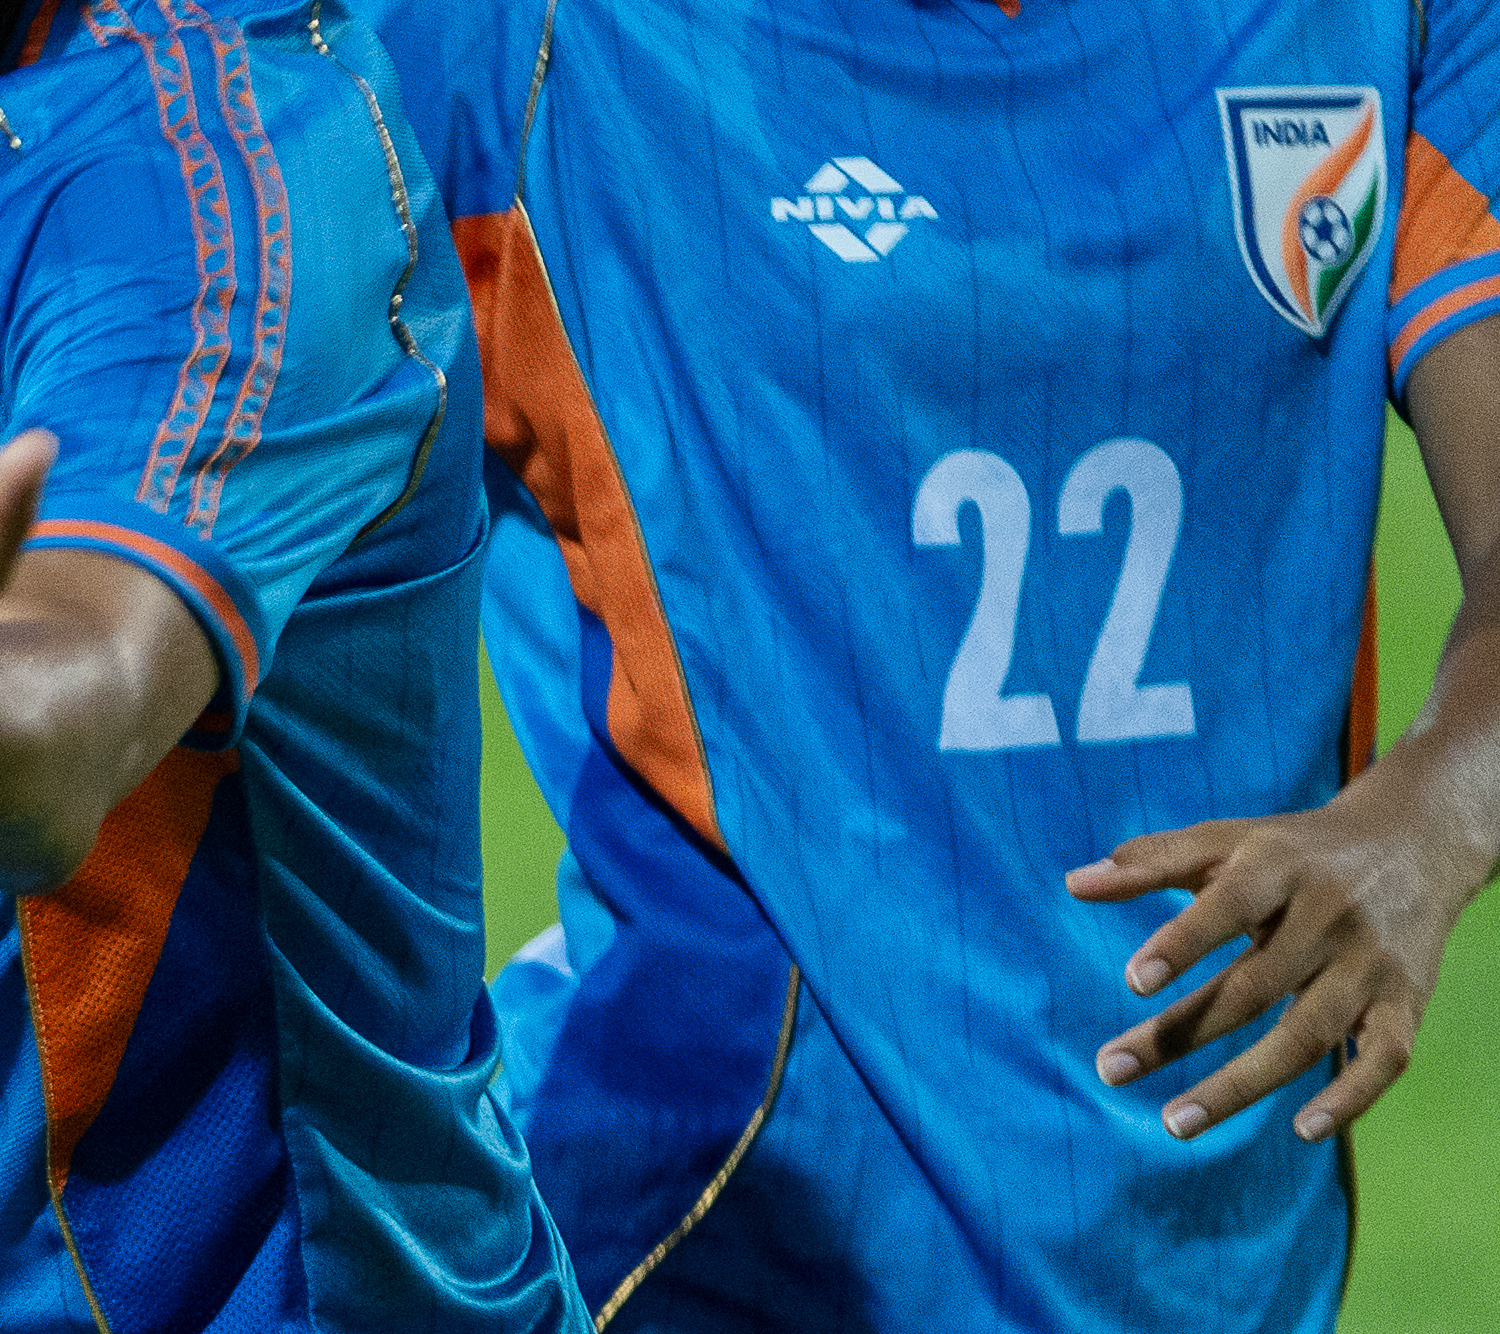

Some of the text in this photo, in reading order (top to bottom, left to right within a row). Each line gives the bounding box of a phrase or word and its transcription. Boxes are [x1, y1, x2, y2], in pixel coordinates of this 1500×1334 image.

[1252, 117, 1331, 147] INDIA
[771, 192, 940, 223] NIVIA
[911, 438, 1197, 751] 22
